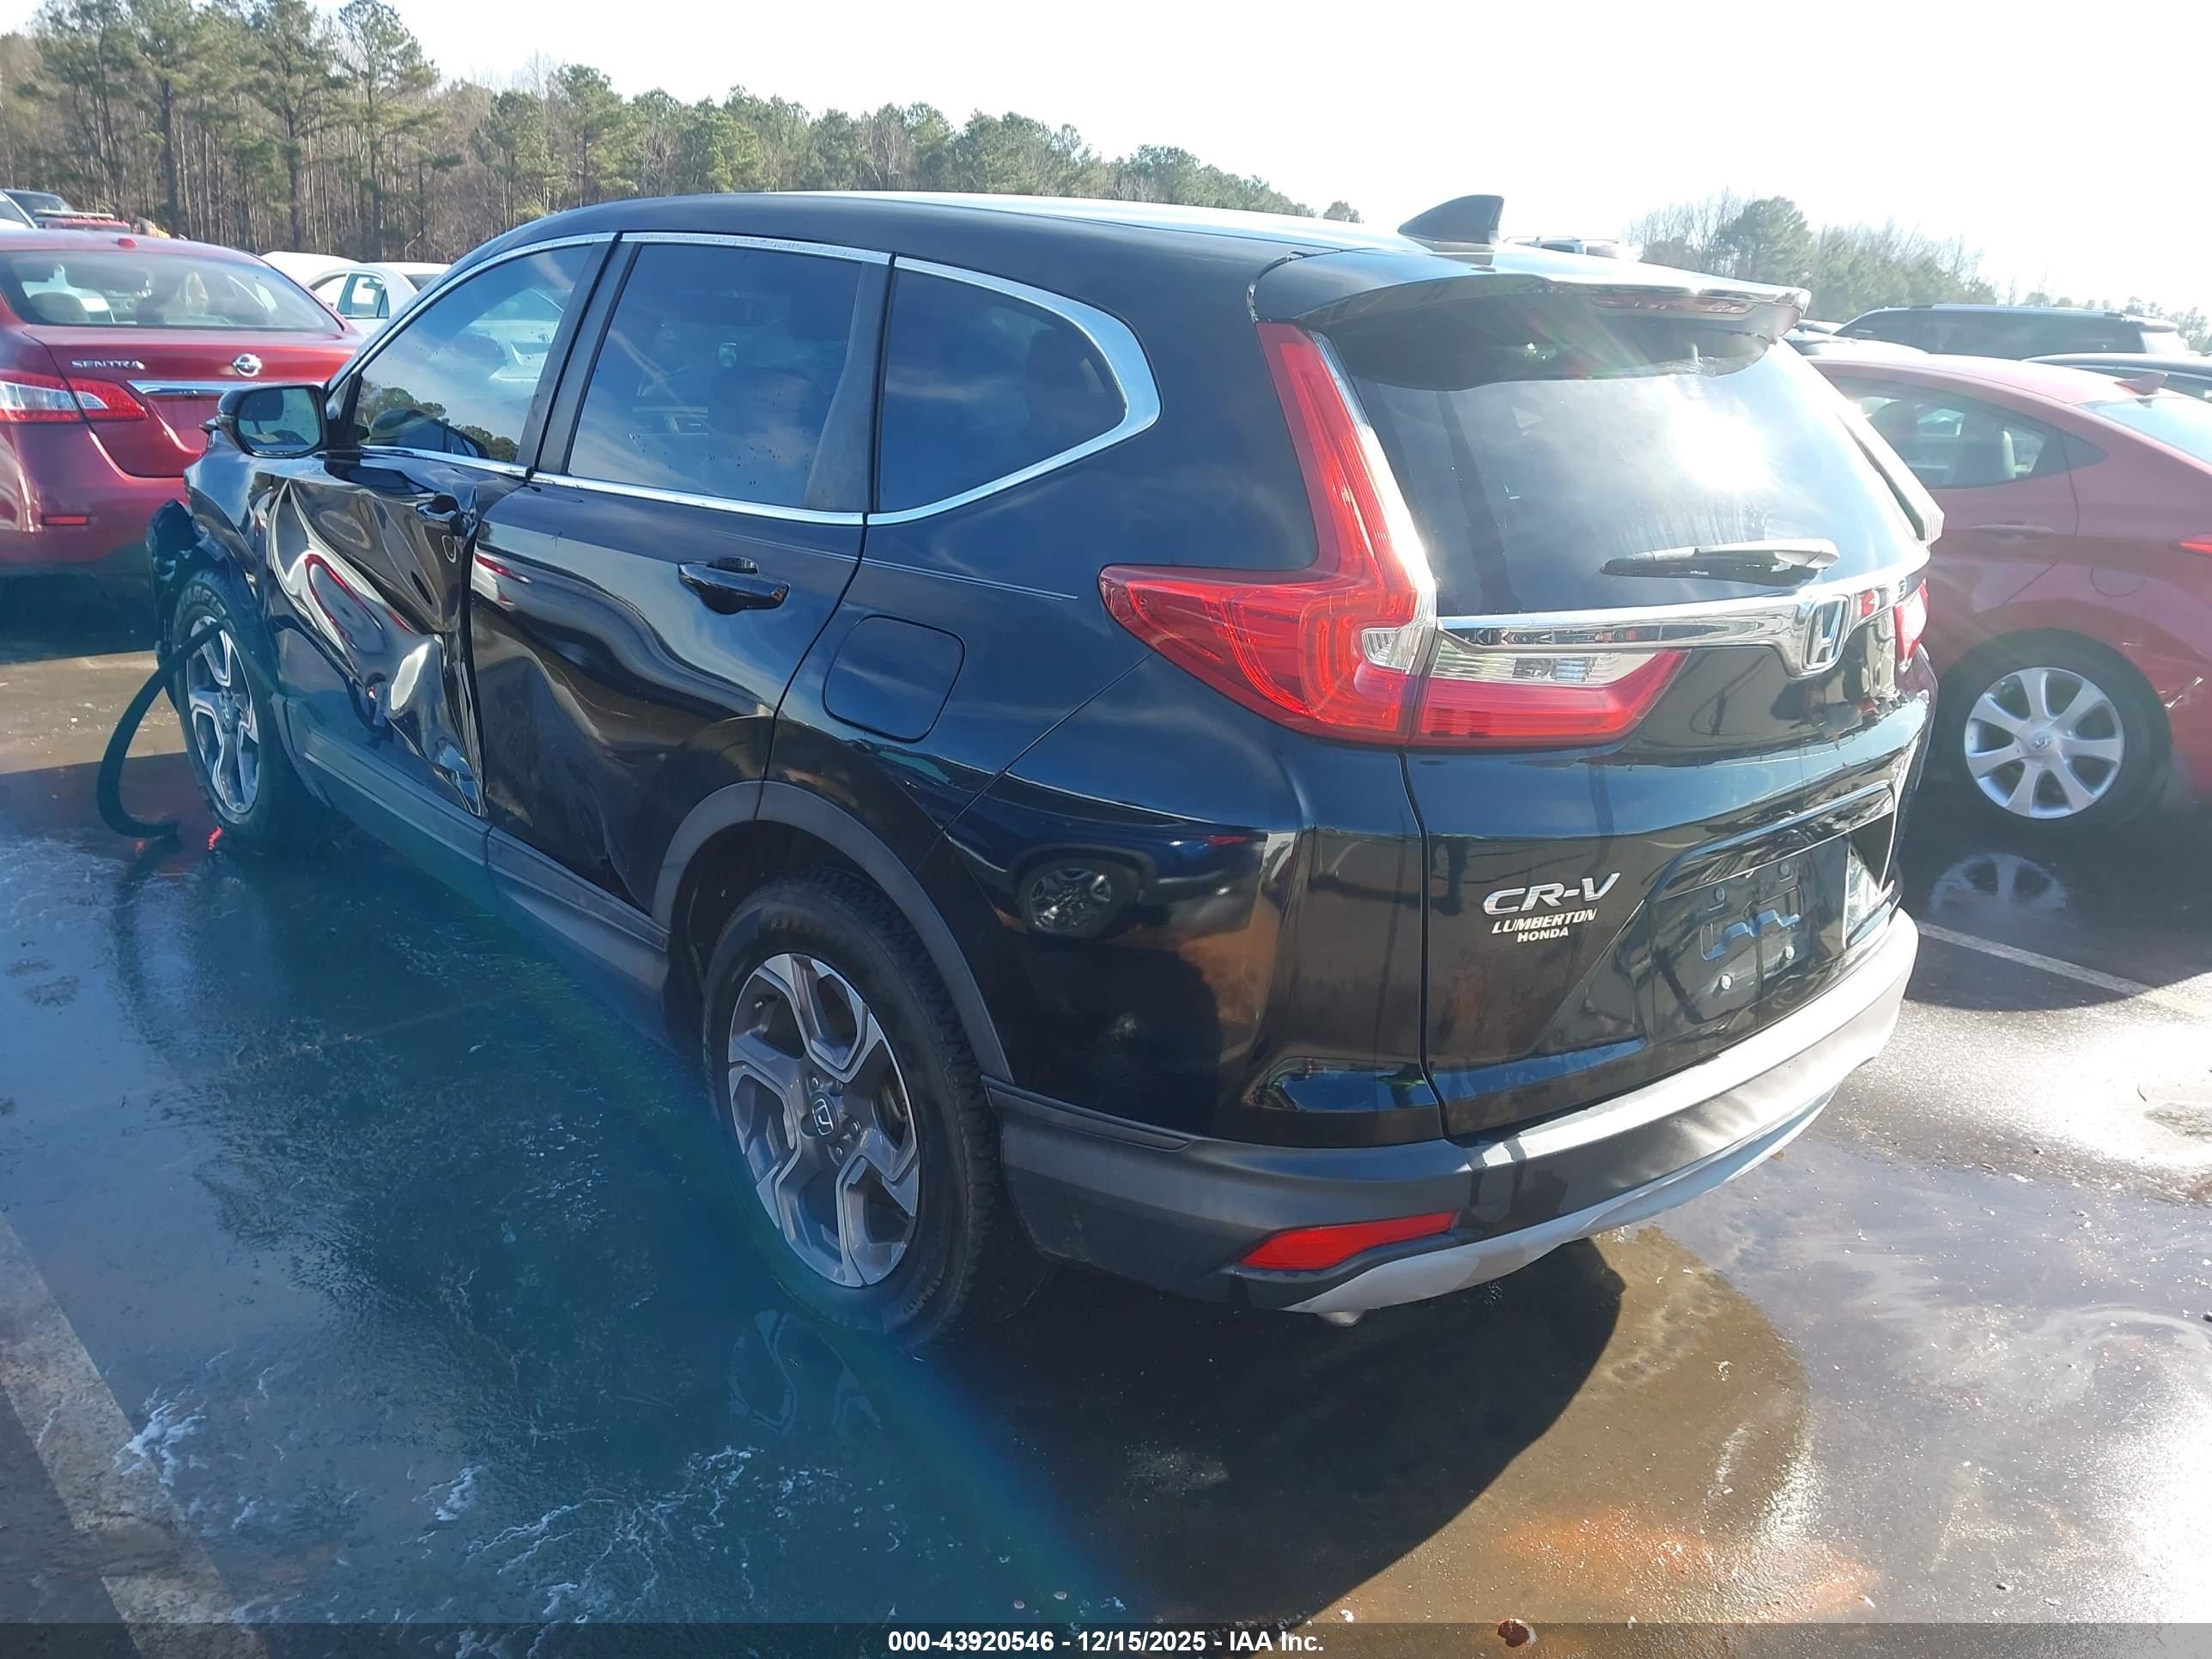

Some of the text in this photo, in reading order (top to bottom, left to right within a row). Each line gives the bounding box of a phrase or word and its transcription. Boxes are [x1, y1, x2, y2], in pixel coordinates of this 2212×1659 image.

[71, 360, 145, 370] SENTRA
[1483, 872, 1621, 915] CR-V
[1492, 908, 1598, 934] LUMBERTON
[1516, 927, 1569, 943] HONDA
